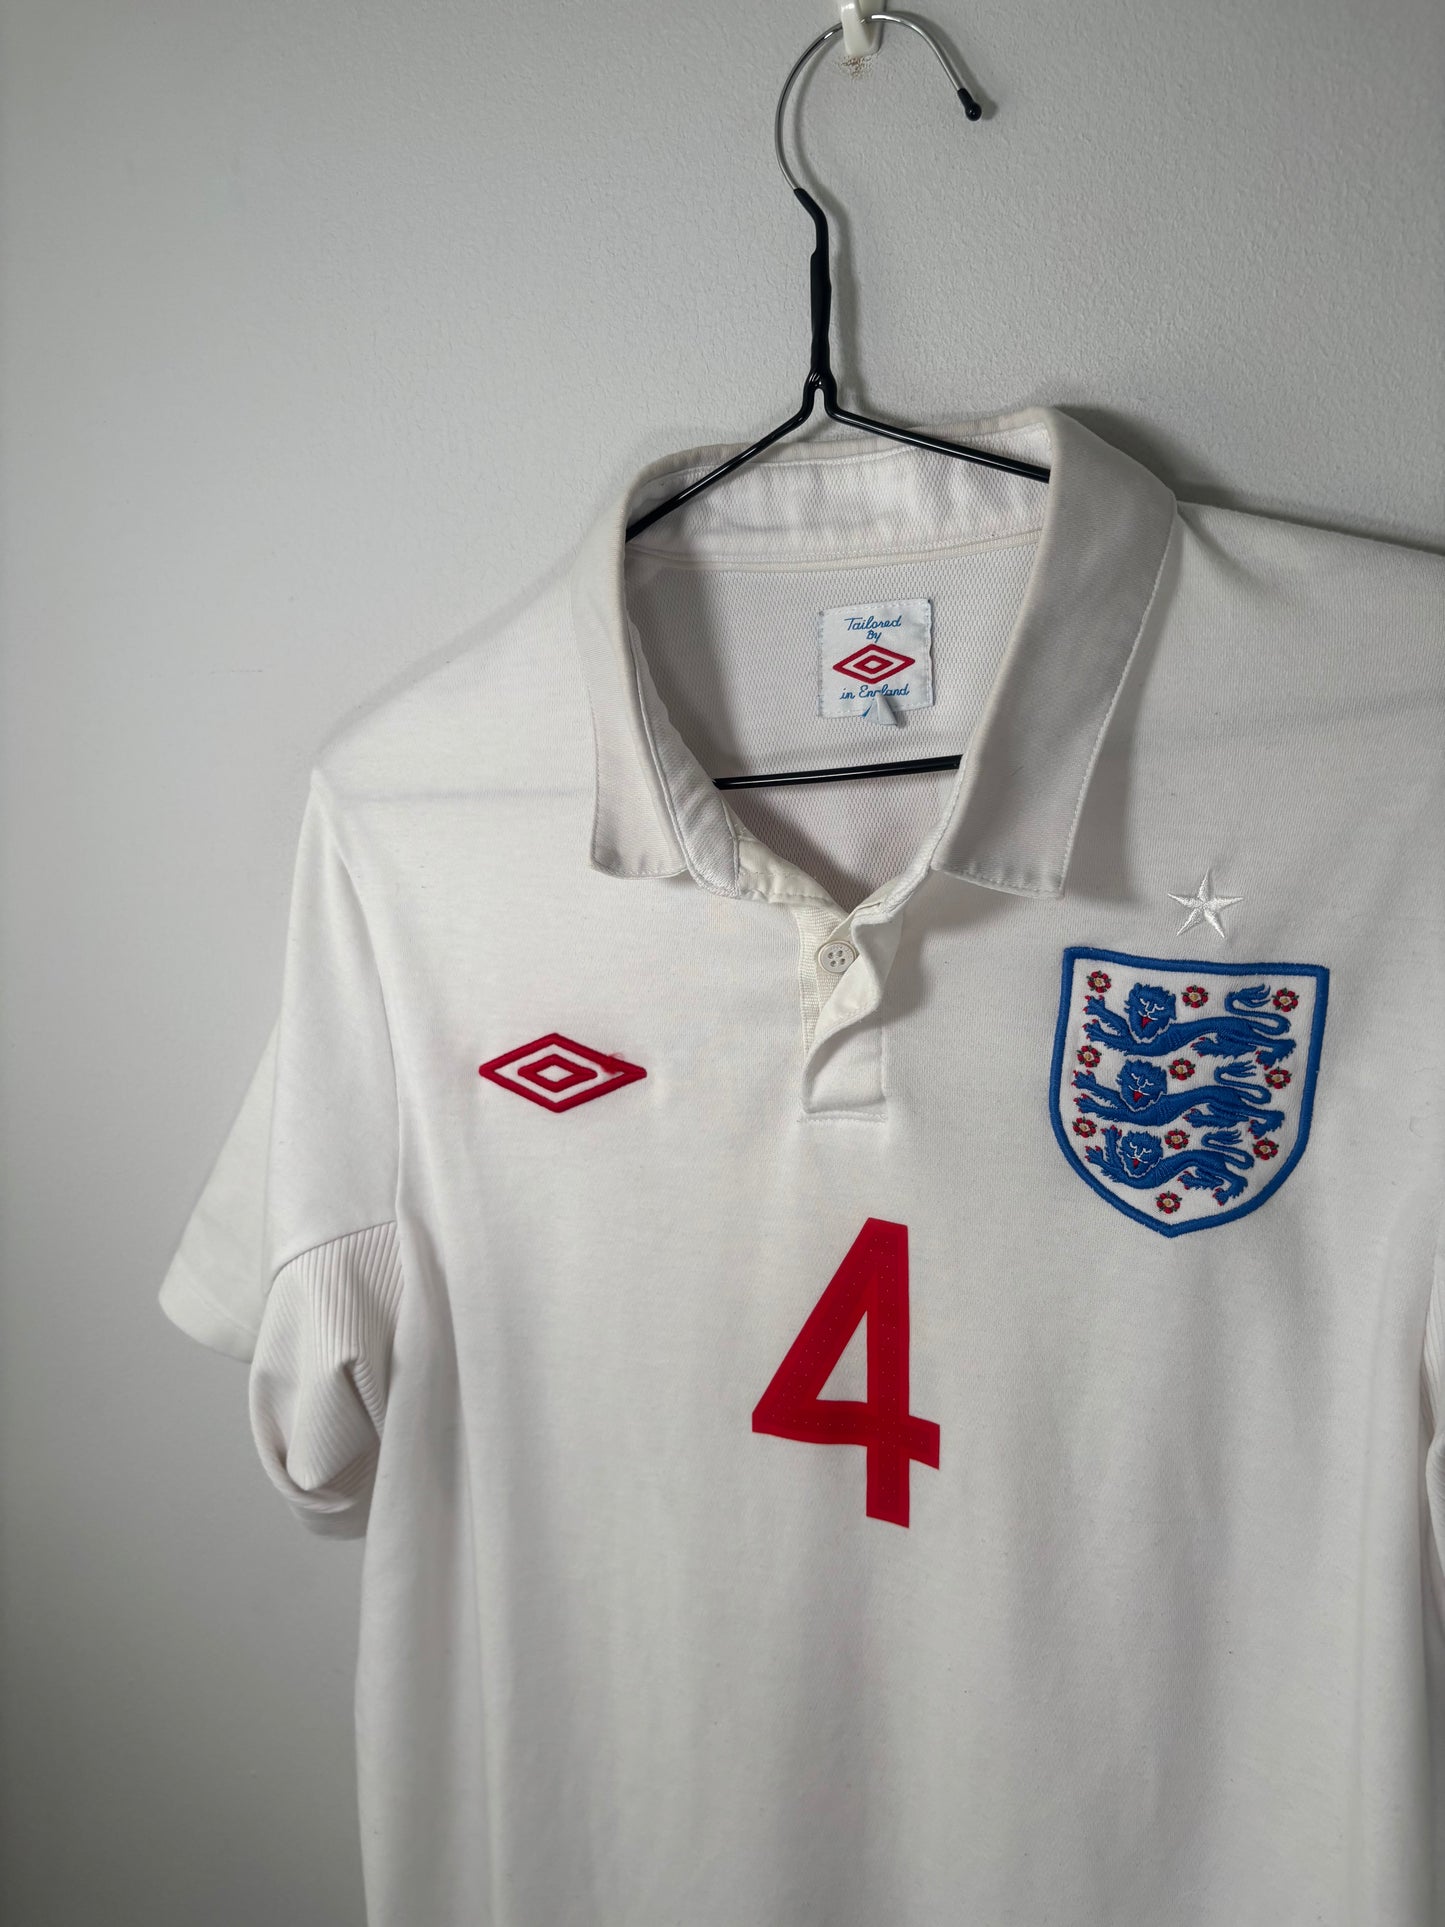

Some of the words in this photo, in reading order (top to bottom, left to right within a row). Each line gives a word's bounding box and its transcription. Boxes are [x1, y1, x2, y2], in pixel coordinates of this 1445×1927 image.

[844, 615, 902, 631] Tailored
[866, 629, 882, 643] By
[840, 688, 856, 700] in
[752, 1217, 941, 1528] 4
